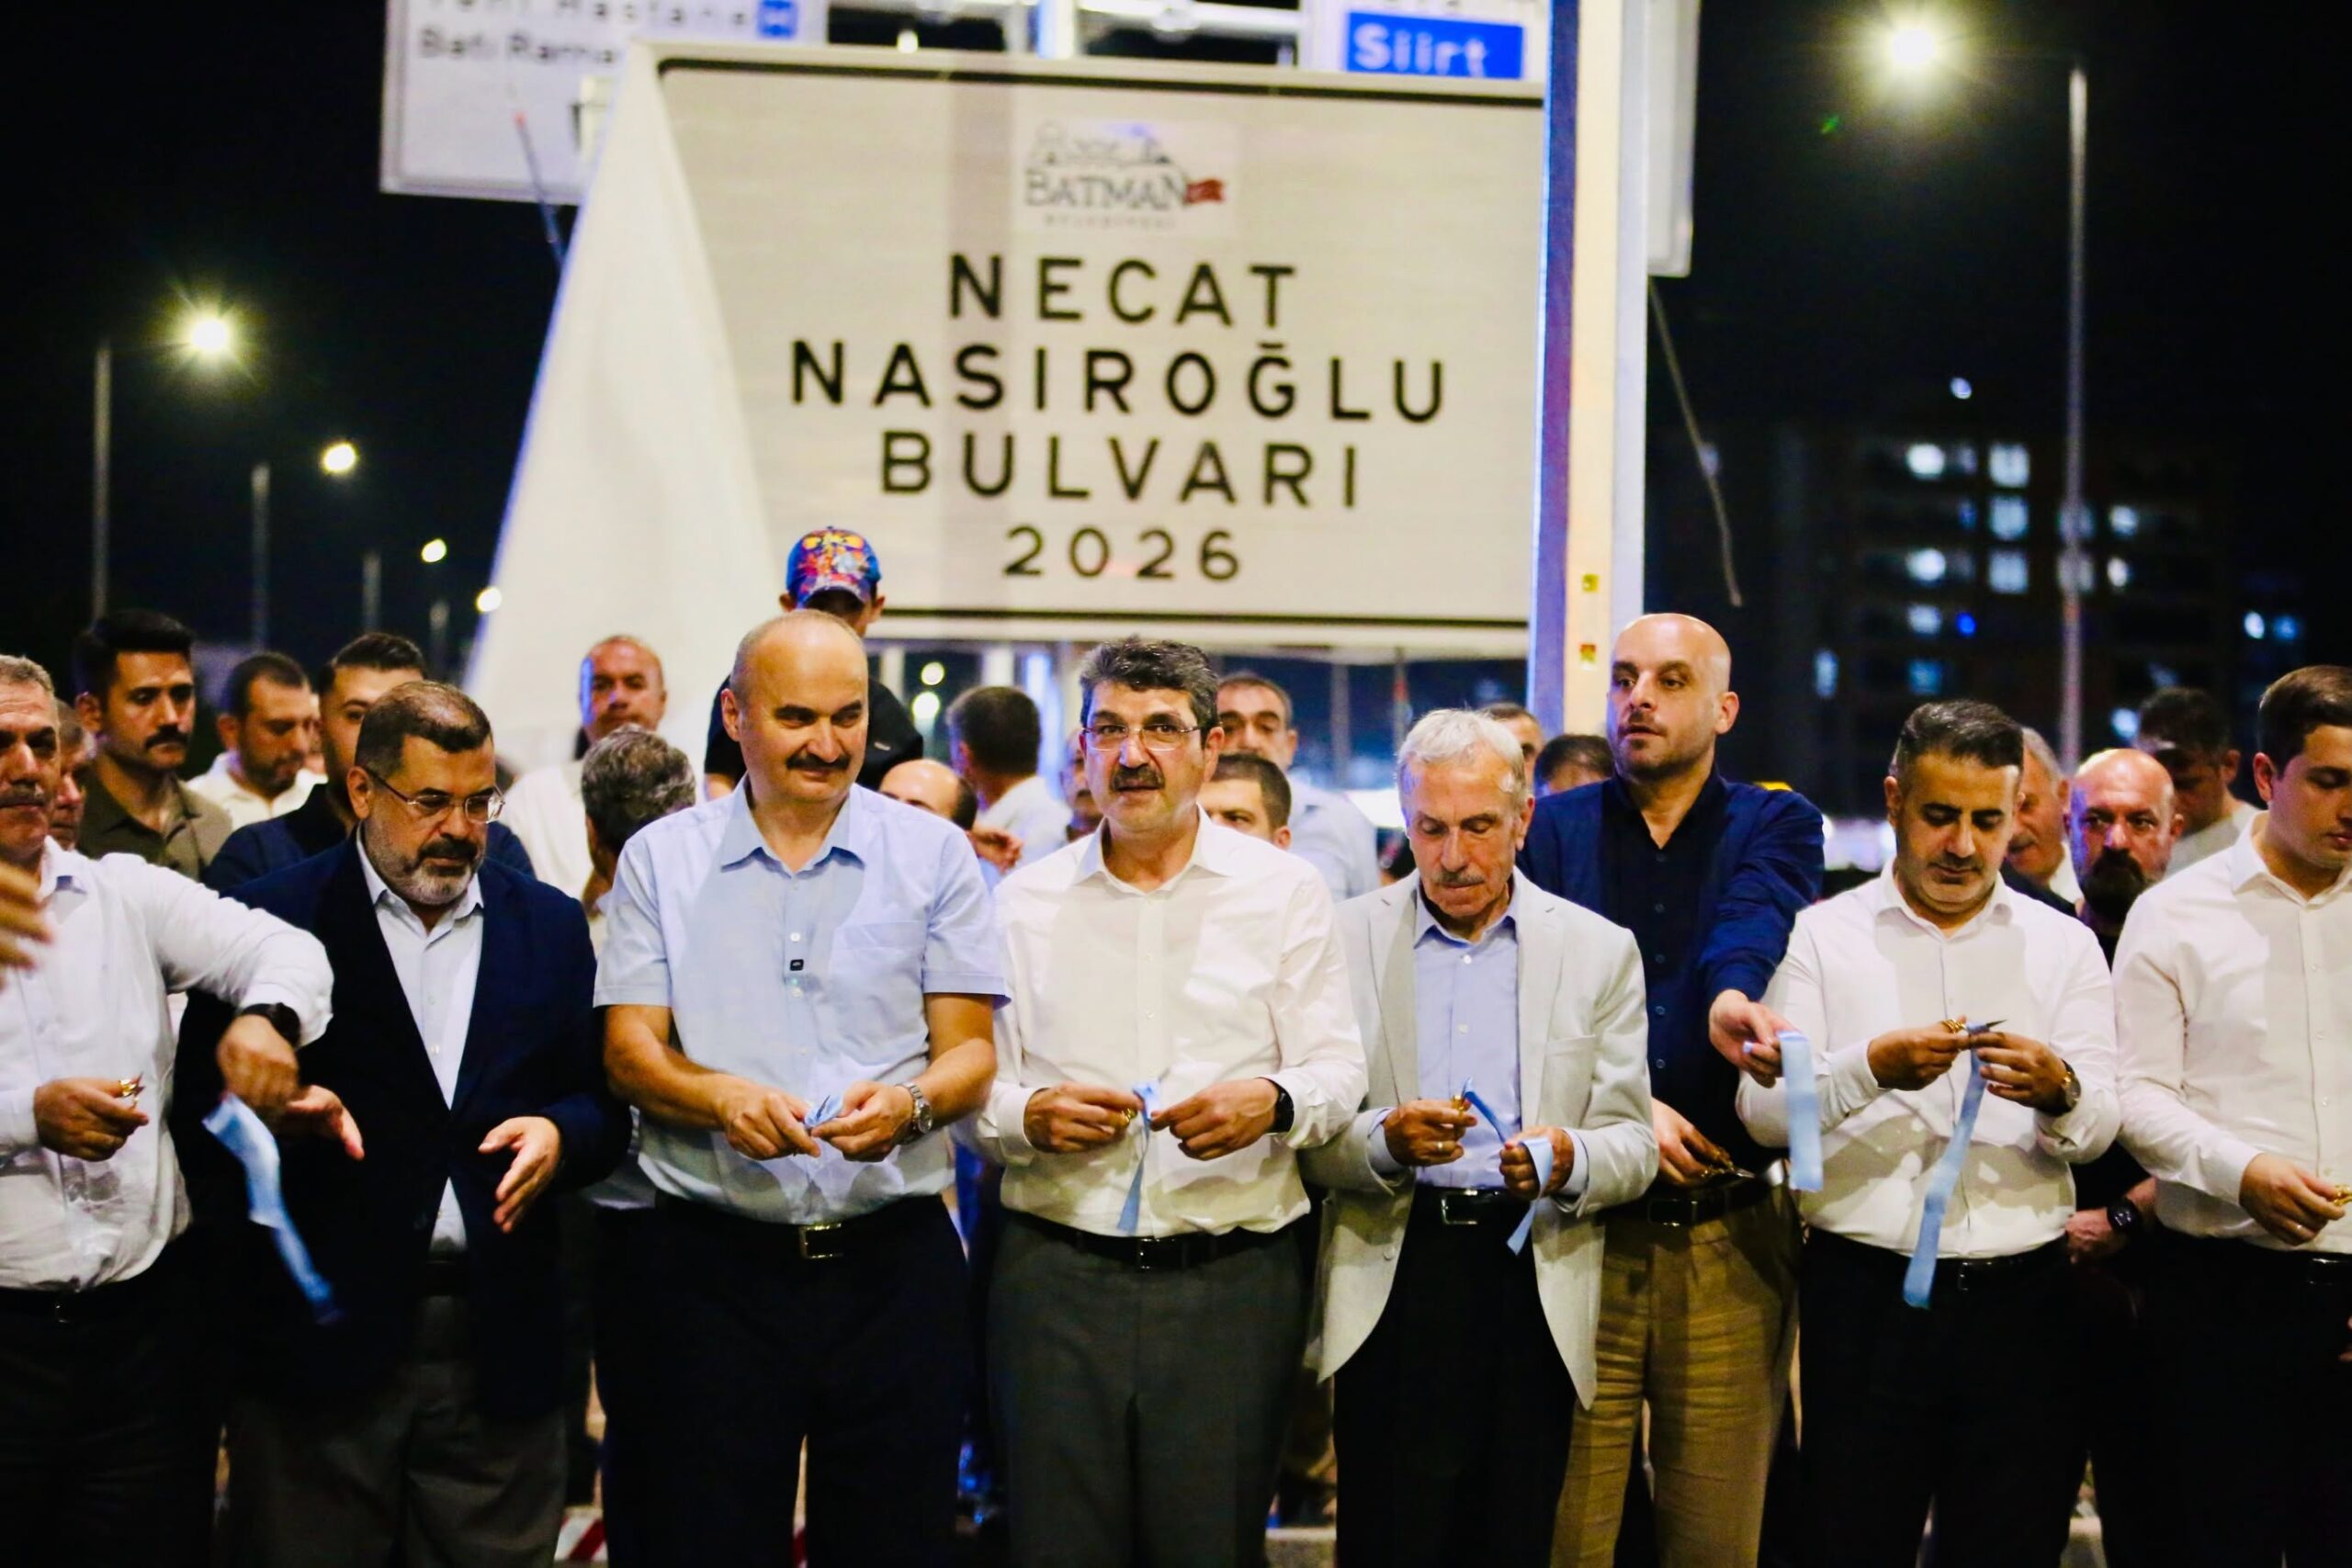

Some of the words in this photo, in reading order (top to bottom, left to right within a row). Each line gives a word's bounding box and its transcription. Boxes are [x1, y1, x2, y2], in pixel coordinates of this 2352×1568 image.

[1353, 23, 1489, 76] Siirt
[1024, 168, 1190, 211] BATMAN
[949, 252, 1295, 328] NECAT
[792, 339, 1442, 424] NASIROĞLU
[881, 430, 1355, 507] BULVARI
[1003, 525, 1239, 581] 2026
